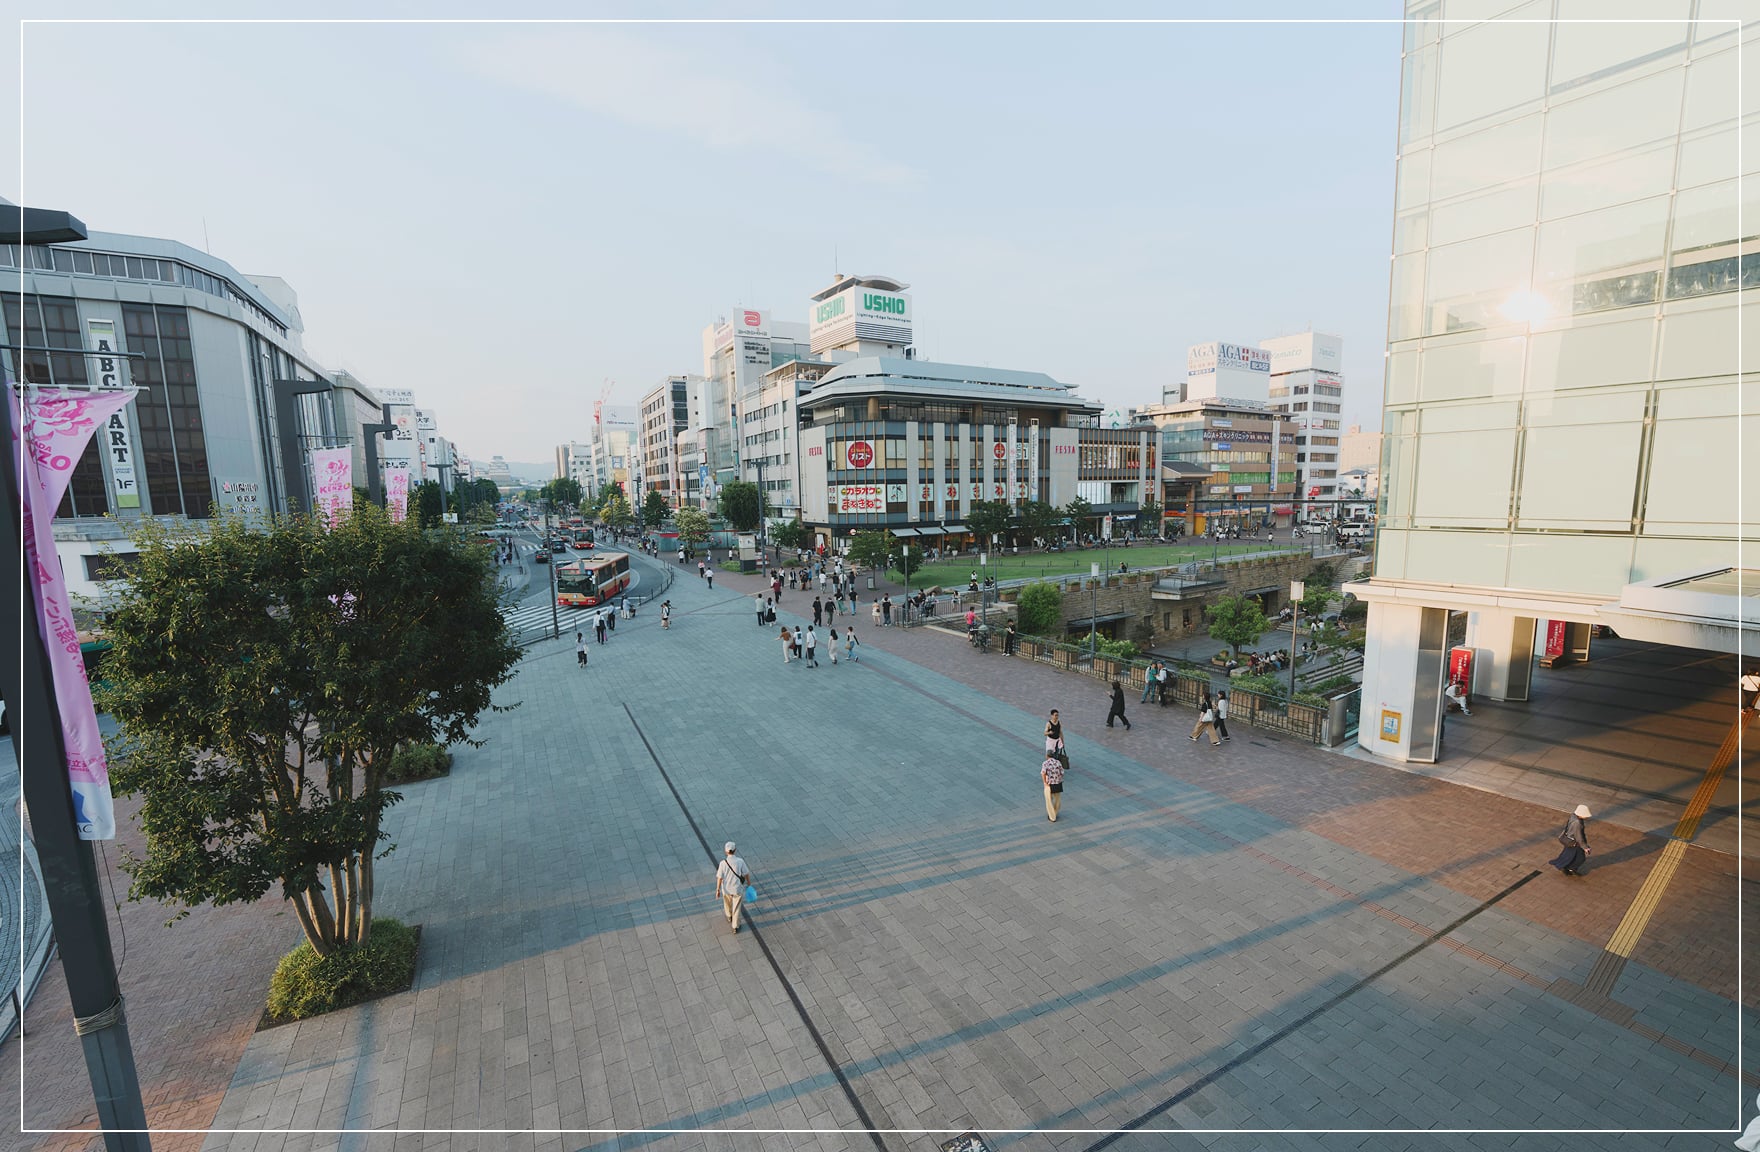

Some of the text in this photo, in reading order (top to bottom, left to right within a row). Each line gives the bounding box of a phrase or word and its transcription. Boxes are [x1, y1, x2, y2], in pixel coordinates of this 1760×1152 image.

[816, 295, 846, 324] USHIO
[863, 293, 905, 315] USHIO
[1218, 344, 1241, 361] AGA
[1055, 445, 1076, 455] FESTA
[116, 478, 134, 489] 1F
[319, 483, 351, 494] KENZO
[841, 498, 883, 511] まねきねこ
